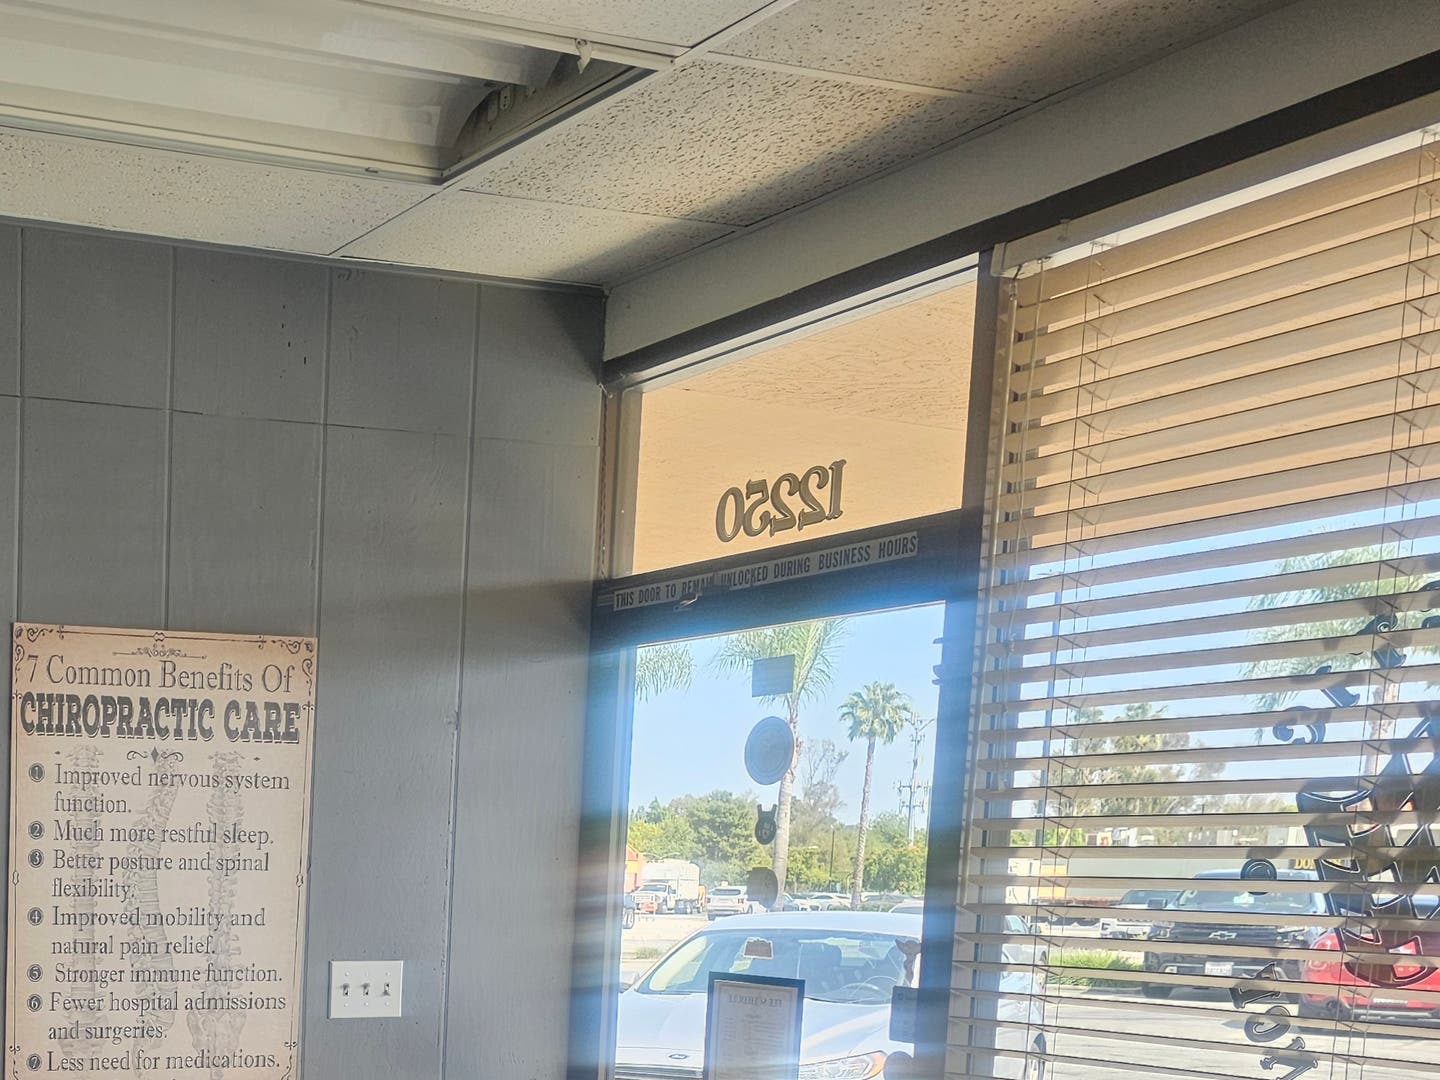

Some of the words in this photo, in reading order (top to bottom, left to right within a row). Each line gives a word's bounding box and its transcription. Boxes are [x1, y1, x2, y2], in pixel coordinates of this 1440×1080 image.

[615, 591, 634, 609] THIS
[638, 587, 660, 604] DOOR
[665, 584, 677, 600] TO
[720, 565, 769, 588] UNLOCKED
[773, 556, 811, 578] DURING
[818, 545, 871, 570] BUSINESS
[877, 535, 918, 560] HOURS
[27, 654, 39, 683] 7
[46, 654, 151, 687] Common
[158, 659, 253, 692] Benefits
[261, 664, 295, 693] Of
[19, 691, 215, 741] CHIROPRACTIC
[223, 699, 301, 744] CARE
[54, 763, 142, 791] Improved
[148, 771, 220, 788] nervous
[225, 771, 290, 794] system
[54, 791, 132, 814] function.
[53, 819, 105, 842] Much
[110, 826, 156, 843] more
[161, 821, 218, 844] restful
[223, 822, 274, 850] sleep.
[52, 849, 105, 870] Better
[109, 853, 173, 875] posture
[178, 852, 211, 870] and
[215, 852, 270, 876] spinal
[51, 878, 136, 903] flexibility.
[52, 905, 140, 931] Improved
[146, 907, 224, 931] mobility
[231, 907, 266, 926] and
[51, 935, 113, 955] natural
[119, 936, 159, 960] pain
[164, 935, 216, 955] relief.
[55, 962, 126, 989] Stronger
[129, 964, 201, 983] immune
[206, 963, 283, 983] function.
[48, 991, 105, 1012] Fewer
[109, 990, 179, 1017] hospital
[184, 990, 287, 1012] admissions
[47, 1020, 79, 1040] and
[84, 1019, 167, 1046] surgeries.
[46, 1050, 84, 1072] Less
[88, 1050, 130, 1071] need
[135, 1049, 161, 1070] for
[165, 1049, 281, 1071] medications.
